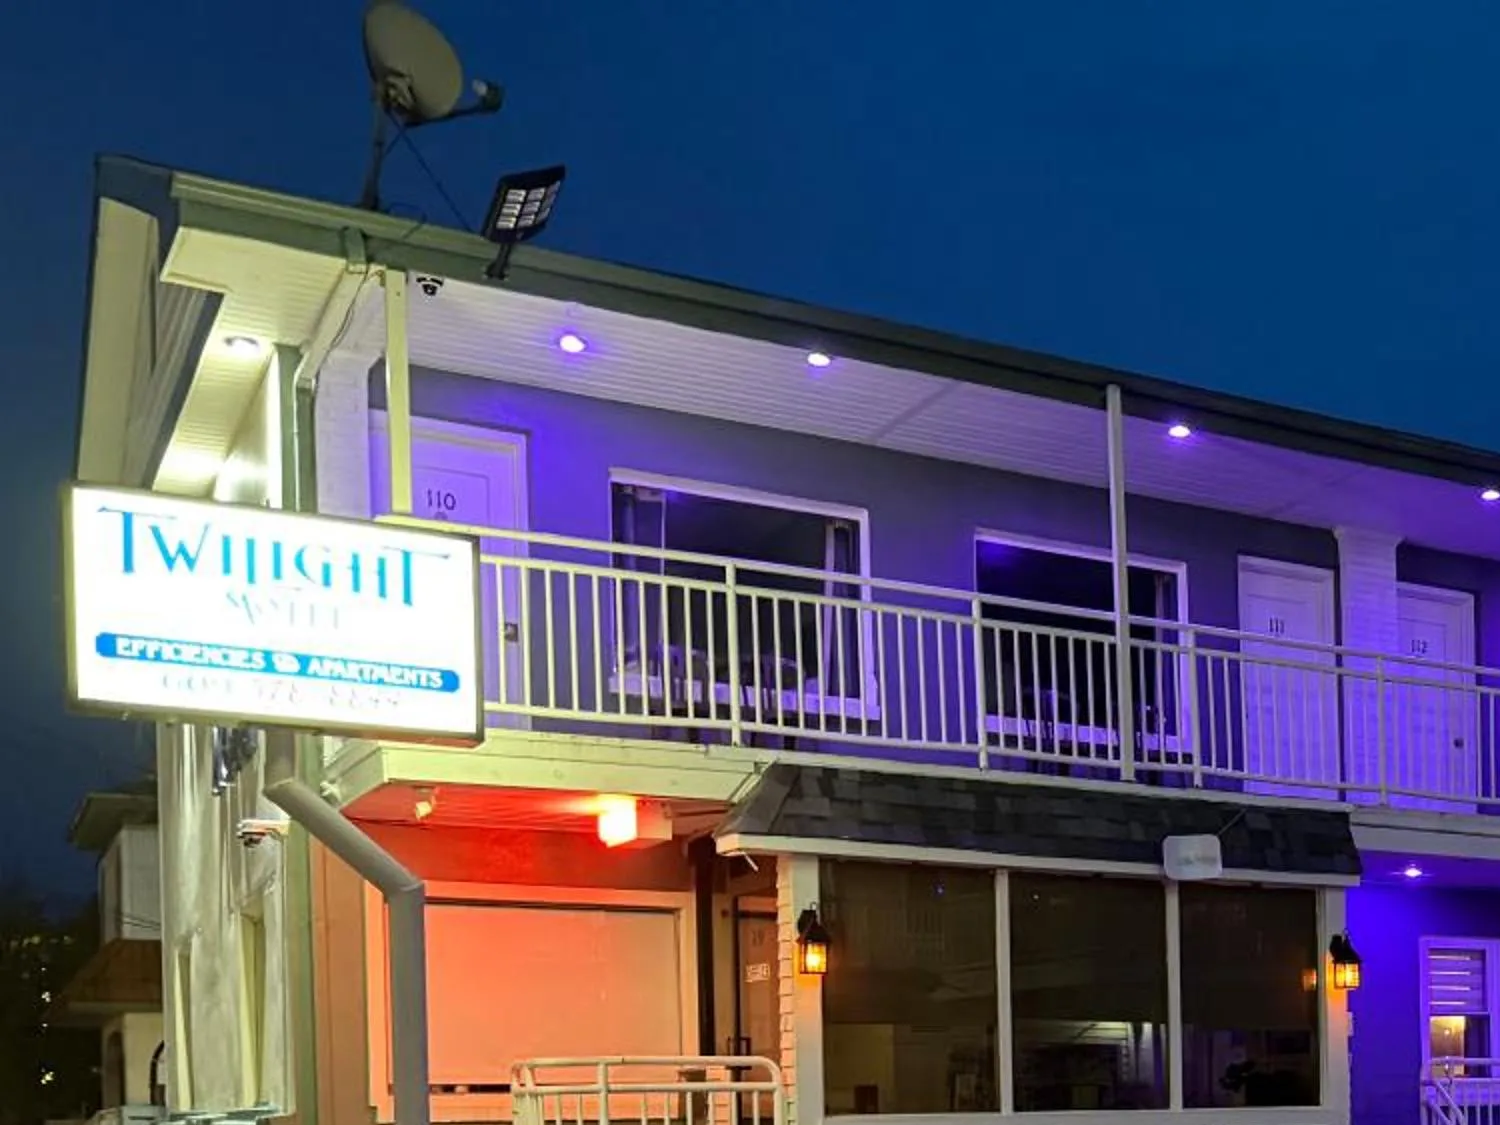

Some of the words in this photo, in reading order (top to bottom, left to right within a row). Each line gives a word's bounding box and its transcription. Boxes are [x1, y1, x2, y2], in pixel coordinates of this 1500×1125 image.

[427, 488, 456, 511] 110
[97, 506, 451, 607] TWILIGHT
[1411, 639, 1427, 654] 112
[306, 655, 444, 690] APARTMENTS
